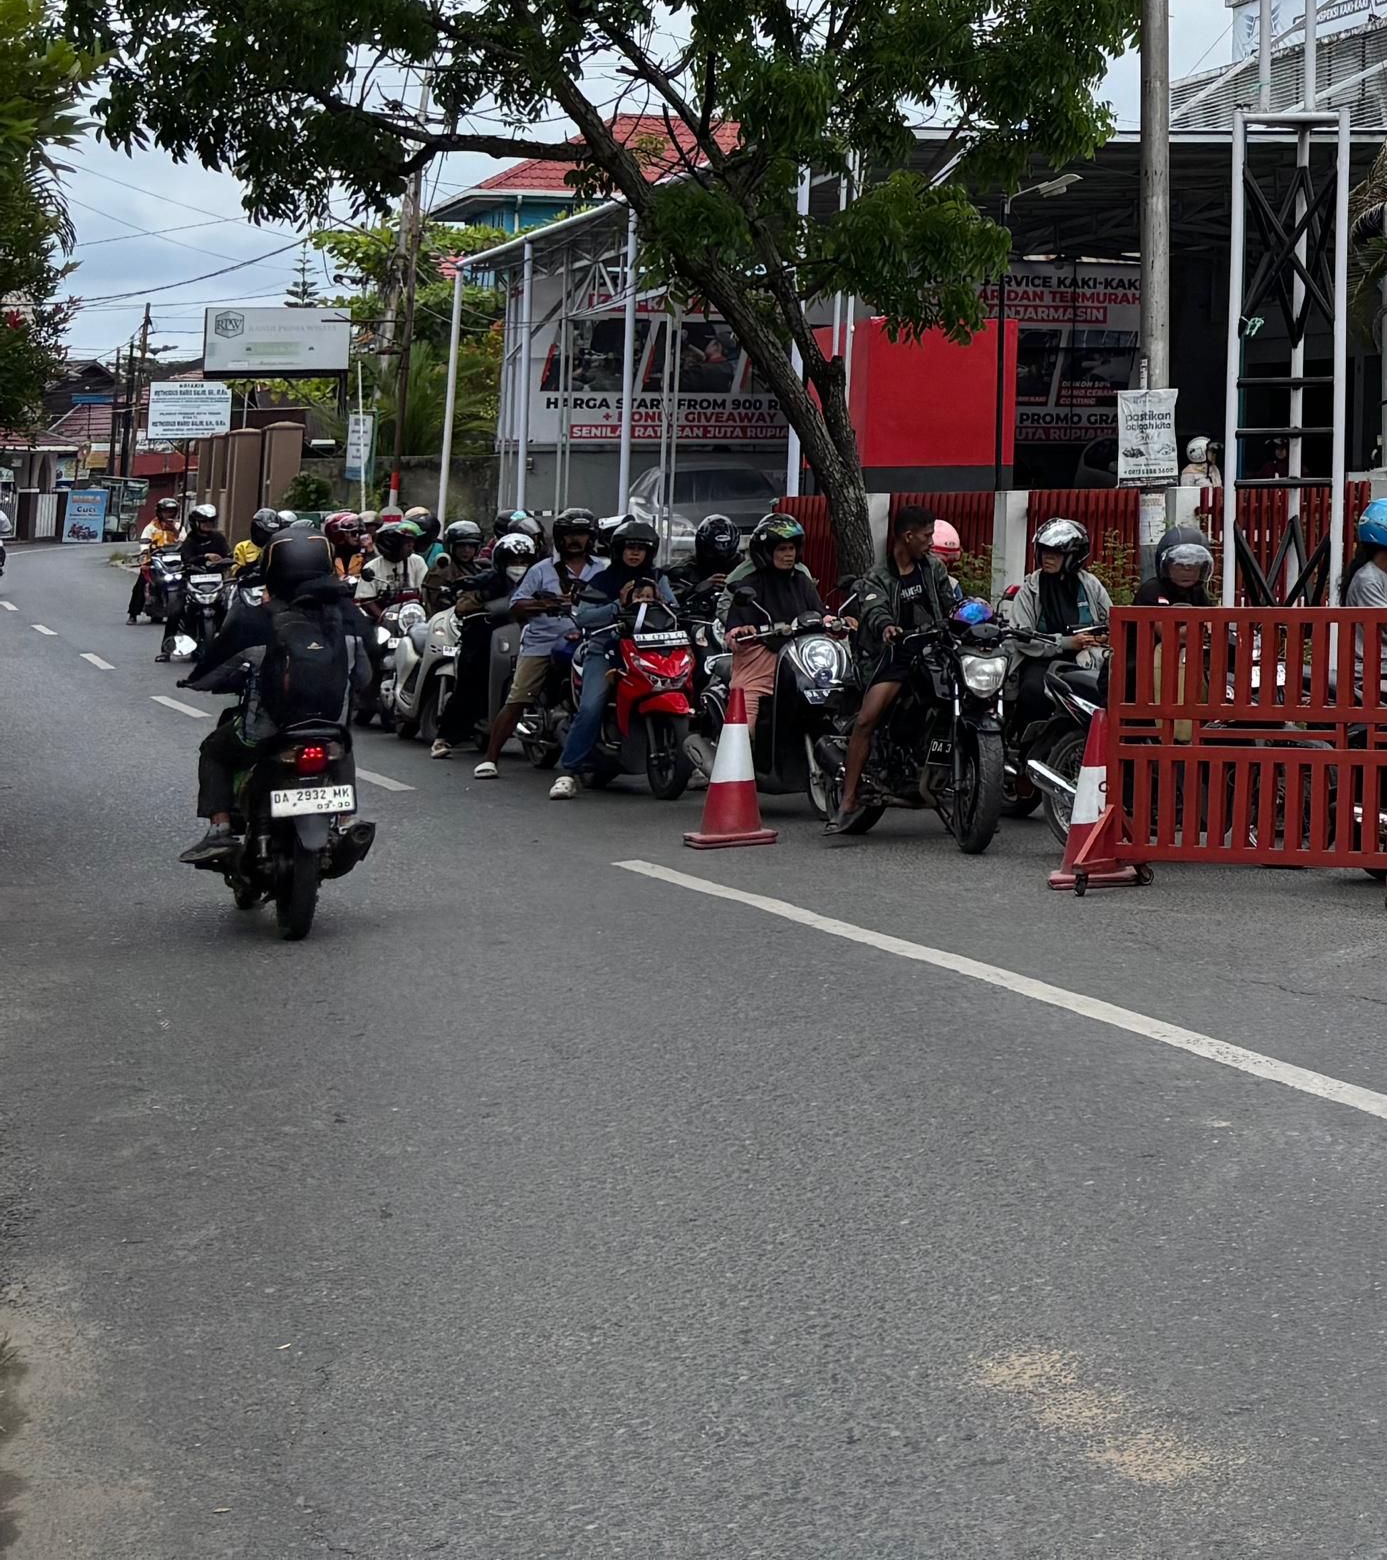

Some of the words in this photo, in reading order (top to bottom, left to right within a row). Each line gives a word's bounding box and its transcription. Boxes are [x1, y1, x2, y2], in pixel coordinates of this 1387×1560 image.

[1006, 290, 1044, 303] DAN
[1051, 290, 1141, 304] TERMURAH
[679, 398, 728, 410] FROM
[731, 399, 764, 411] 900
[684, 412, 777, 424] GIVEAWAY
[1020, 413, 1082, 426] PROMO
[1126, 411, 1171, 424] pastikan
[706, 427, 745, 438] JUTA
[932, 741, 943, 752] DA
[274, 792, 289, 803] DA
[296, 789, 326, 801] 2932
[333, 787, 350, 798] MK
